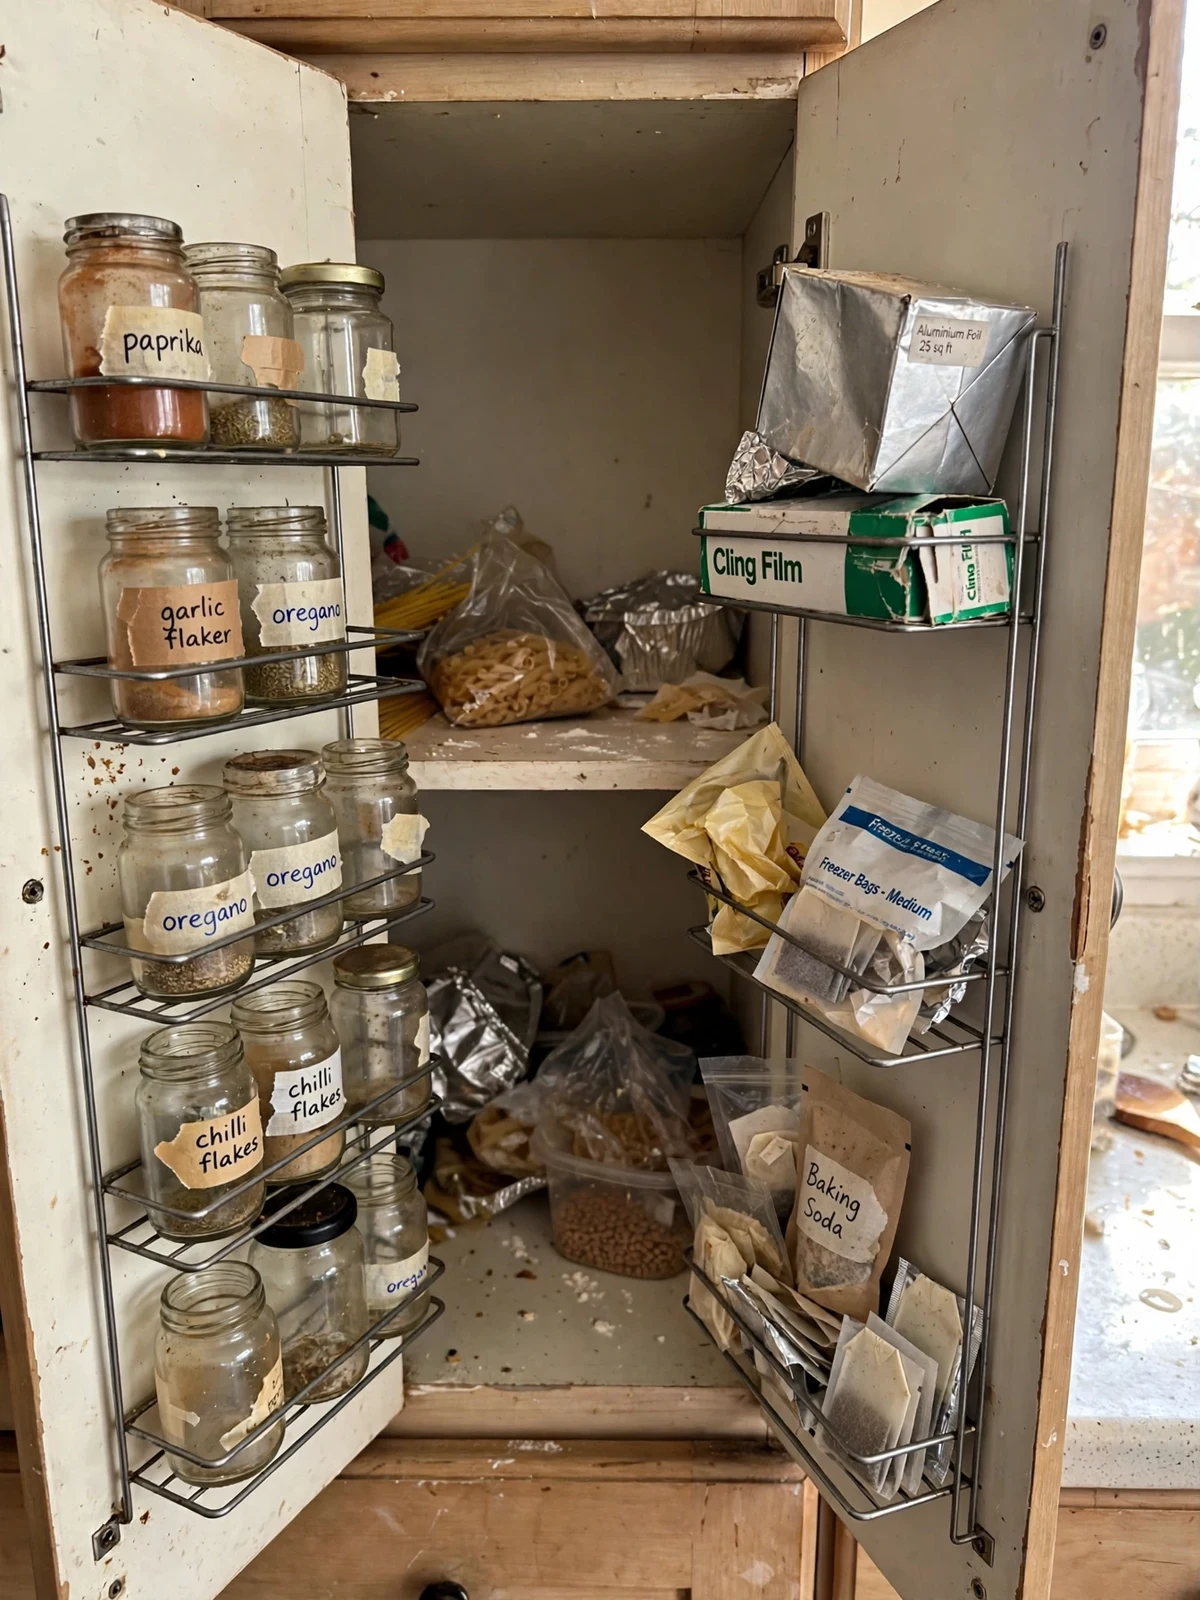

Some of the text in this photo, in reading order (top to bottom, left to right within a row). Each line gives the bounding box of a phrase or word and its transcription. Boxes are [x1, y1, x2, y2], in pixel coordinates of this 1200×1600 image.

[123, 328, 203, 364] paprika
[917, 324, 982, 340] Aluminium Foil
[919, 340, 952, 356] 25 sq ft
[713, 547, 803, 585] Cling Film
[161, 596, 225, 632] garlic
[272, 603, 341, 632] oregano
[164, 626, 231, 650] flaker
[267, 855, 337, 890] oregano
[818, 856, 856, 883] Freezer
[854, 873, 880, 895] Bags
[885, 887, 933, 921] Medium
[163, 898, 248, 936] oregano
[288, 1067, 332, 1098] chilli
[290, 1088, 341, 1121] flakes
[195, 1115, 247, 1149] chilli
[199, 1136, 259, 1173] flakes
[806, 1162, 860, 1222] Baking
[803, 1197, 842, 1239] Soda
